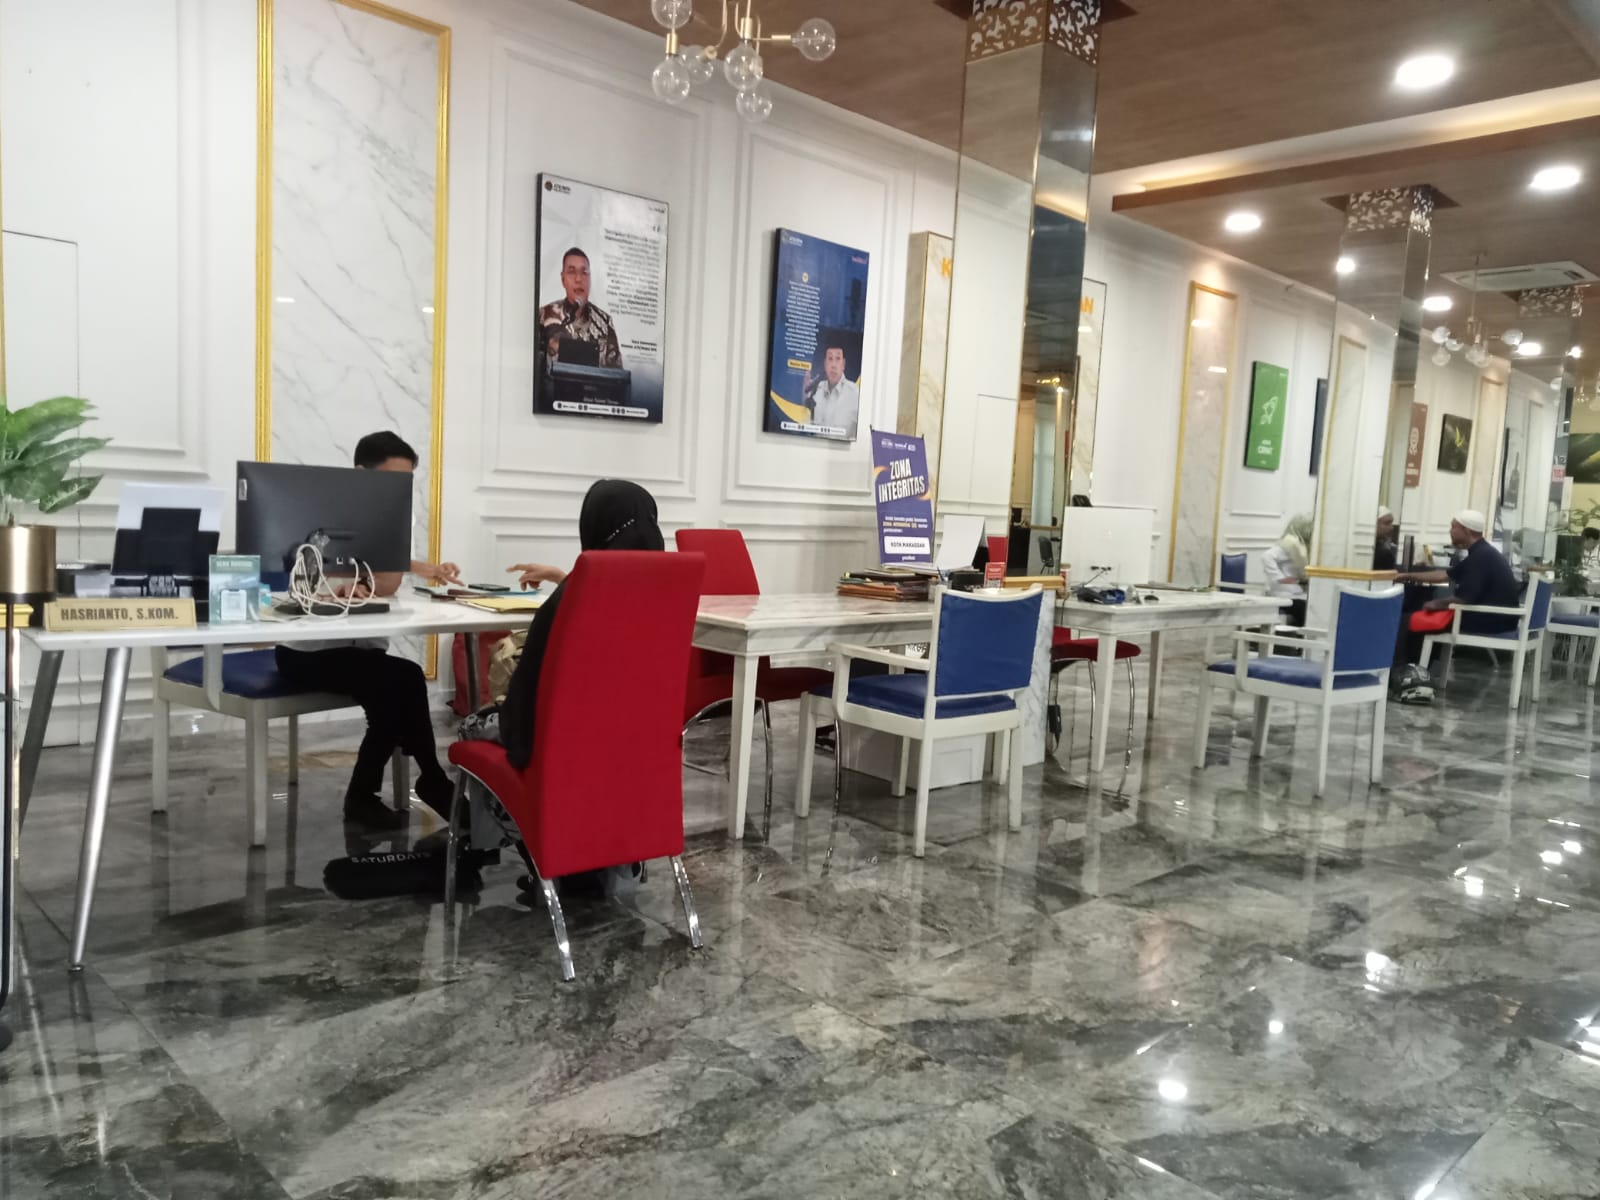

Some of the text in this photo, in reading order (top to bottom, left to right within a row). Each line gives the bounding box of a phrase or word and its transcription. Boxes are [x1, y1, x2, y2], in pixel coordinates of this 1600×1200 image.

[889, 458, 912, 480] ZONA
[878, 475, 926, 503] INTEGRITAS
[61, 607, 179, 621] HASRIANTO, S.KOM.
